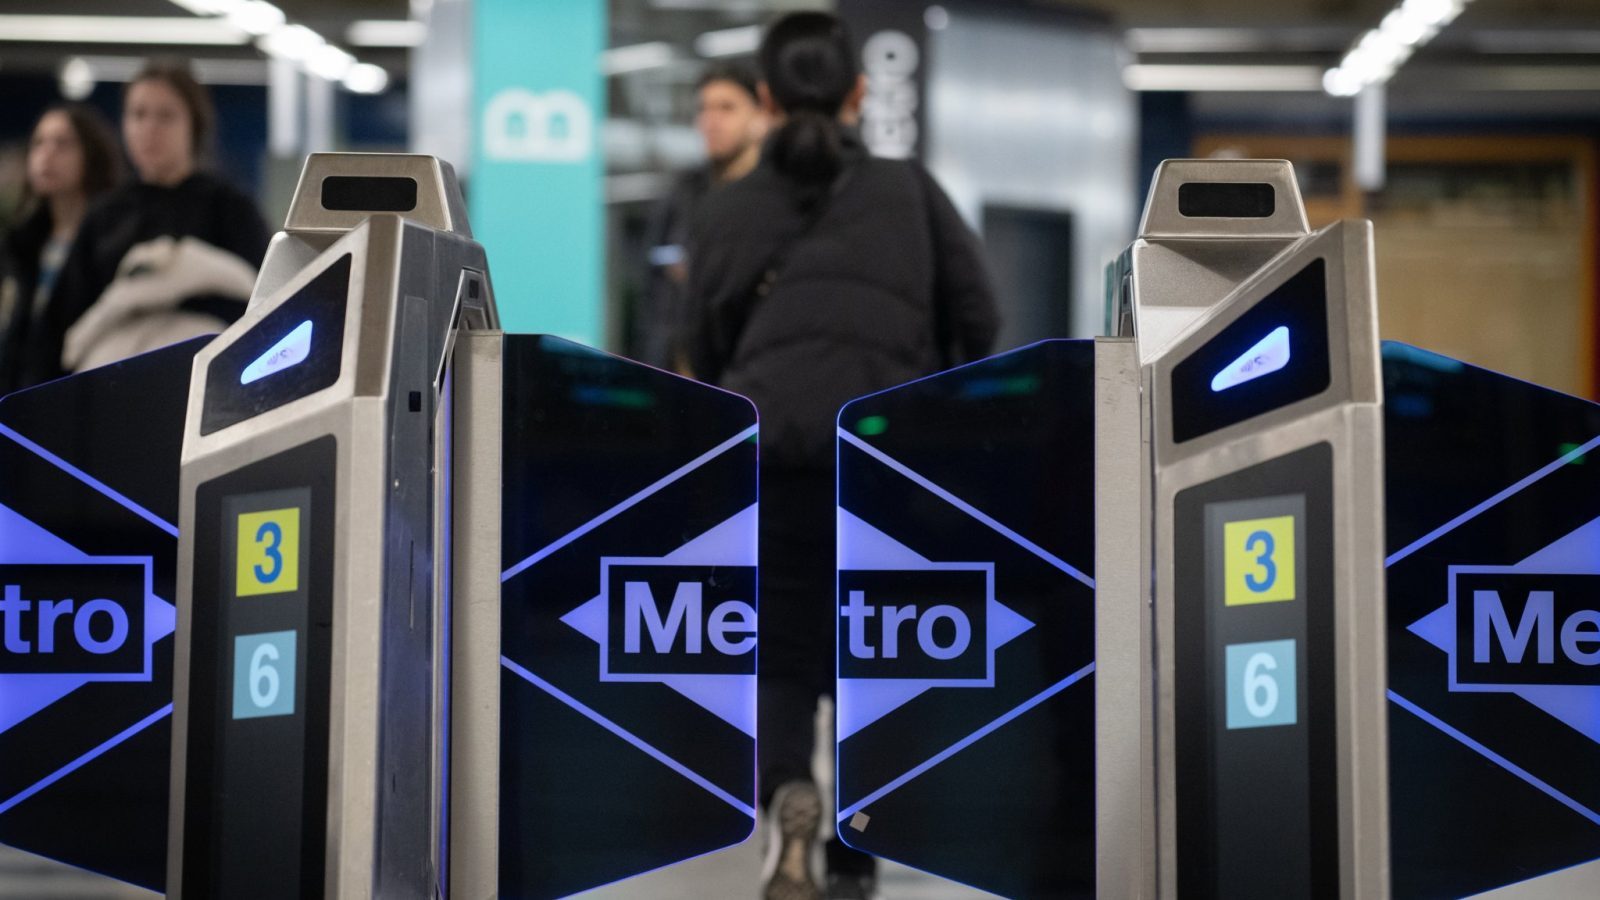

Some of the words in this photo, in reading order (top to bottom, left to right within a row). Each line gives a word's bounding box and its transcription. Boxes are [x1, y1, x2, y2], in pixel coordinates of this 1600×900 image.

[484, 87, 592, 162] B
[253, 521, 283, 584] 3
[1244, 530, 1277, 593] 3
[0, 585, 129, 654] tro
[624, 581, 757, 656] Me
[840, 590, 972, 660] tro
[1473, 590, 1600, 666] Me
[249, 643, 280, 708] 6
[1244, 652, 1278, 718] 6
